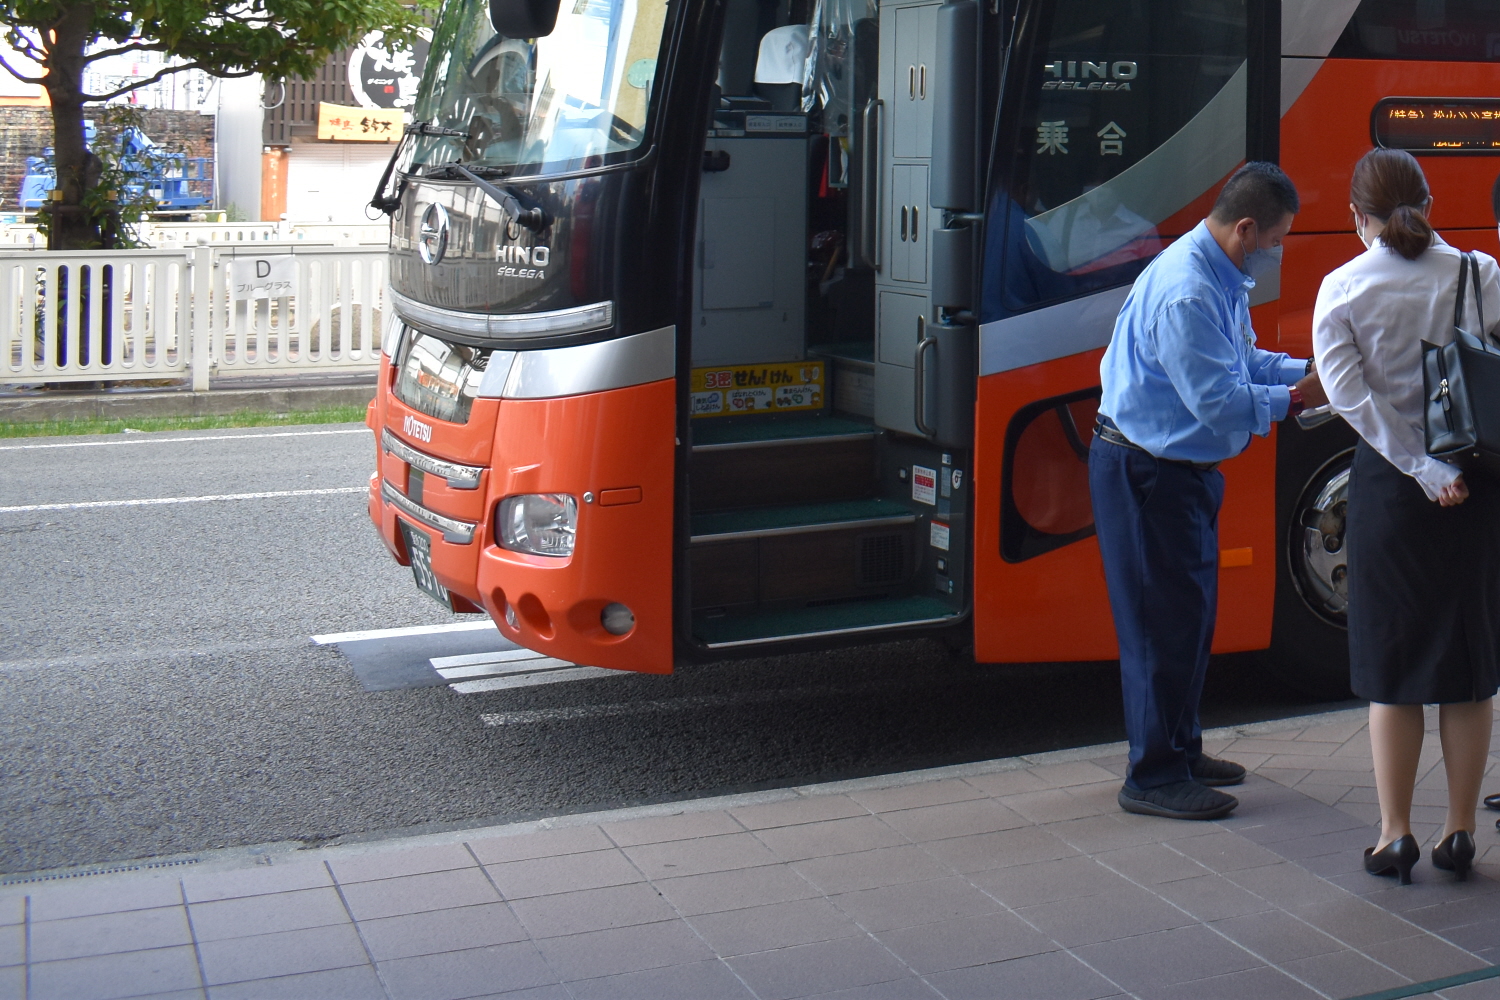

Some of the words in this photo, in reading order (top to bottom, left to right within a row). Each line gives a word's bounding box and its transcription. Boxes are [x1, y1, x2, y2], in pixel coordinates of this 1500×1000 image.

[496, 244, 550, 267] HINO
[256, 260, 271, 278] D
[237, 281, 292, 293] ブルーグラス
[403, 415, 432, 443] IYOTETSU
